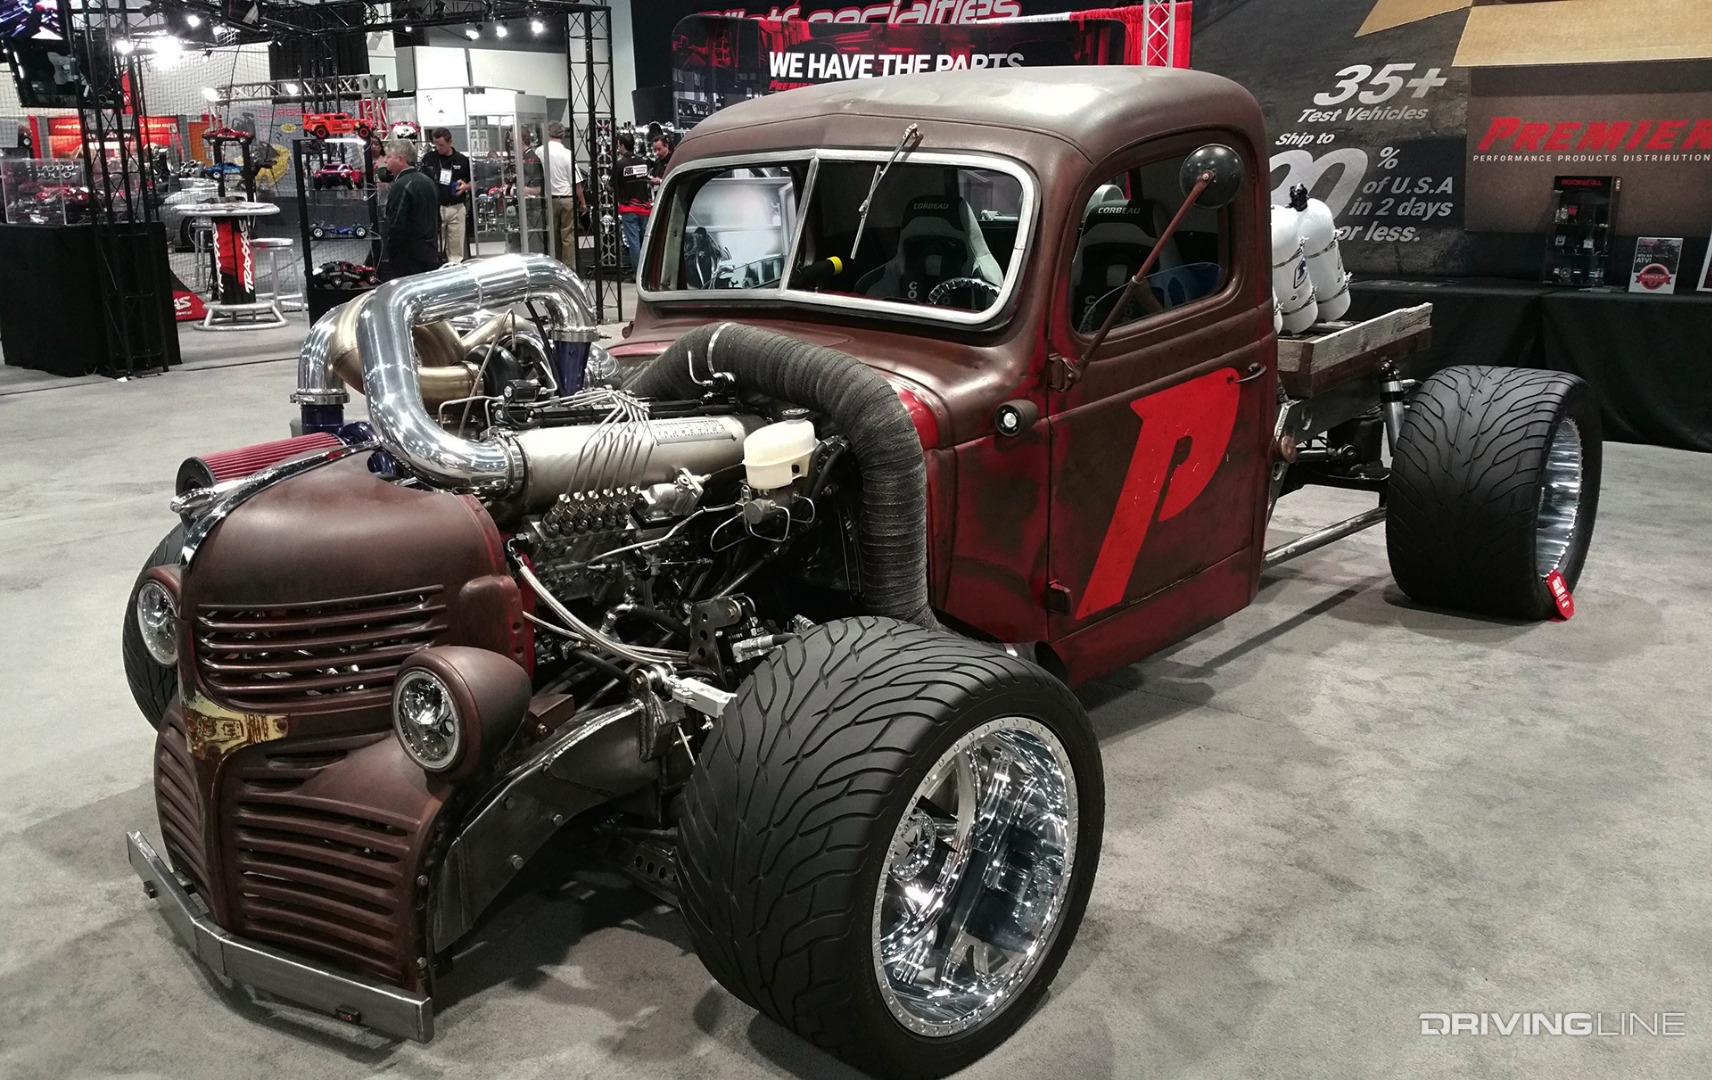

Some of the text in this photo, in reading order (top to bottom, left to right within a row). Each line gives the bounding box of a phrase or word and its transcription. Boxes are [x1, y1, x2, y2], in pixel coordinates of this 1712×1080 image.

[769, 52, 804, 78] WE
[807, 53, 875, 79] HAVE
[878, 54, 930, 77] THE
[1313, 63, 1447, 106] 35+
[1297, 106, 1429, 123] Test Vehicles
[1275, 132, 1336, 148] Ship to
[1477, 117, 1712, 151] PREMIER
[1377, 146, 1400, 170] %
[1473, 153, 1711, 162] PERFORMANCE PRODUCTS DISTRIBUTION
[1362, 177, 1453, 194] of U.S.A
[913, 202, 950, 210] CORBEAU
[1098, 206, 1141, 215] CORBEAU
[1349, 197, 1453, 221] in 2 days
[1337, 221, 1420, 242] or less.
[238, 219, 255, 294] TRAXXAS
[1075, 367, 1240, 620] P
